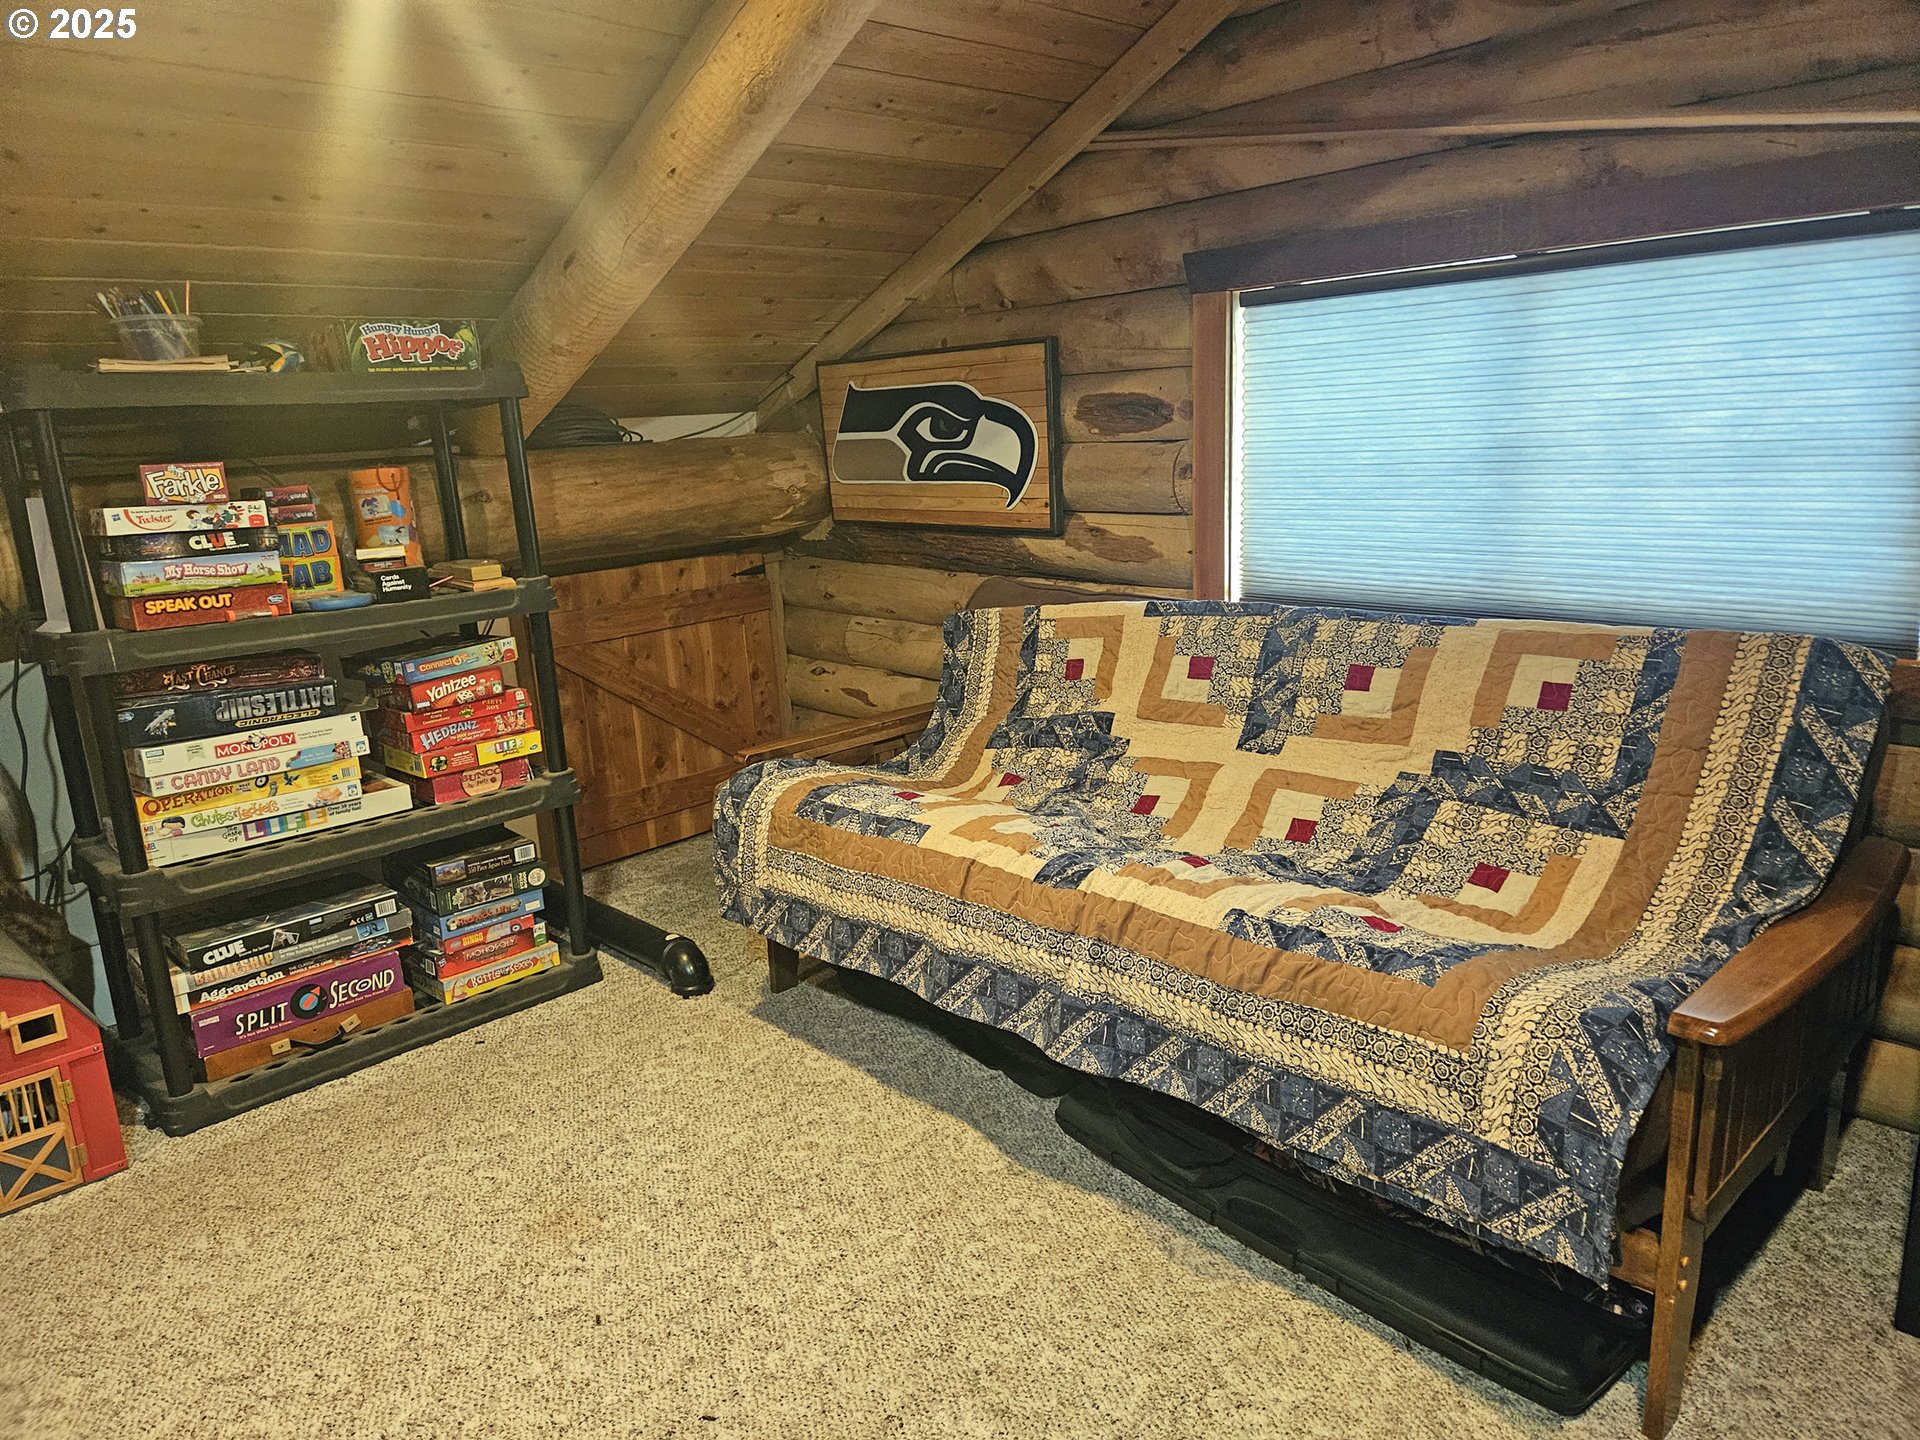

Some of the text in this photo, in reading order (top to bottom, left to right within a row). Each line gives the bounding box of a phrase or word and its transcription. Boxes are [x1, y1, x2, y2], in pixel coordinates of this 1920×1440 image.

[361, 323, 440, 336] Hungry Hungry
[362, 333, 464, 362] Hippos
[145, 468, 220, 499] Farkle
[136, 514, 173, 525] Twister
[188, 531, 237, 550] CLUE
[164, 562, 248, 579] My Horse Show
[382, 584, 412, 592] Humanity
[145, 594, 232, 614] SPEAK OUT
[426, 674, 477, 703] Yahtzee
[216, 684, 336, 722] BATTLESHIP
[239, 709, 318, 727] ELECTRONIC
[216, 734, 294, 758] MONOPOLY
[420, 720, 479, 750] HEDBANZ
[494, 738, 525, 754] LIFE
[170, 765, 232, 790] CANDY
[237, 757, 281, 778] LAND
[143, 785, 234, 817] OPERATION
[191, 809, 234, 828] Chutes
[244, 807, 328, 841] LIFE
[462, 931, 484, 947] BINGO
[466, 935, 517, 960] MONOPOLY
[202, 939, 246, 965] CLUE
[193, 951, 274, 987] BATTLESHIP
[470, 970, 502, 988] Battle
[199, 970, 285, 1004] Aggravation
[235, 968, 395, 1036] SPLIT SECOND
